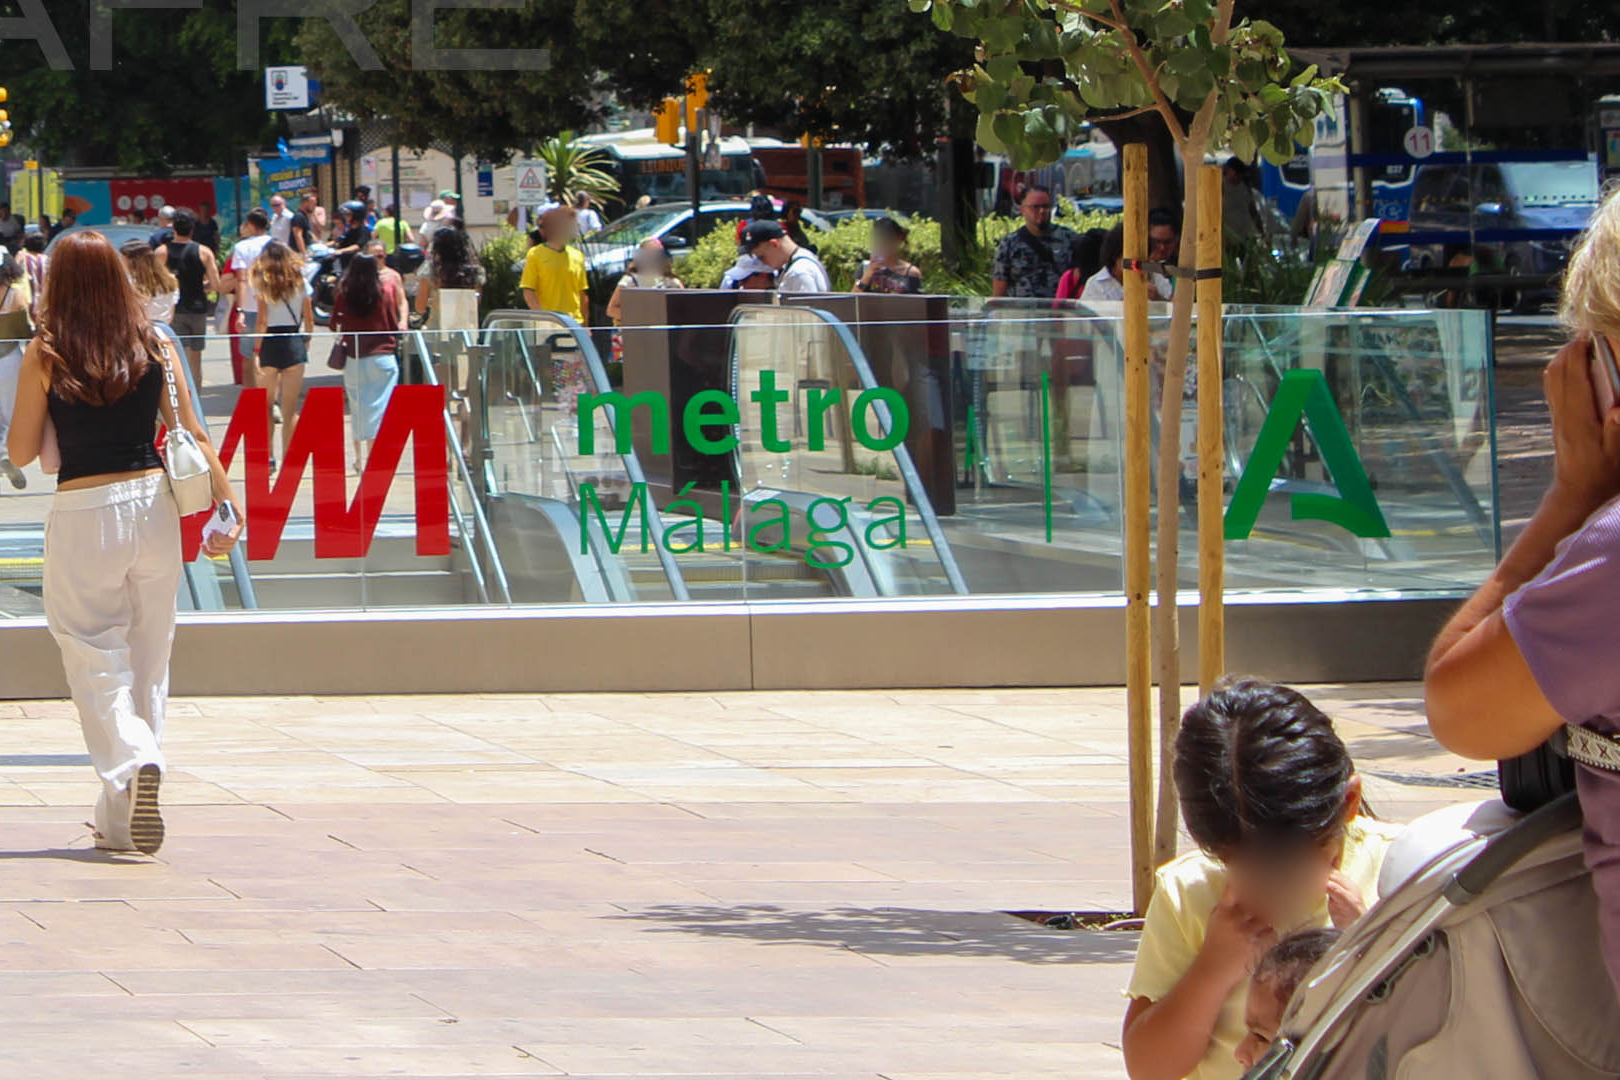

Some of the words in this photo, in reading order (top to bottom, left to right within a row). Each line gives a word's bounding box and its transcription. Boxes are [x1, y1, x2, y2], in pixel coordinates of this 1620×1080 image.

[1410, 132, 1431, 153] 11
[579, 370, 910, 456] metro
[579, 481, 908, 569] Málaga
